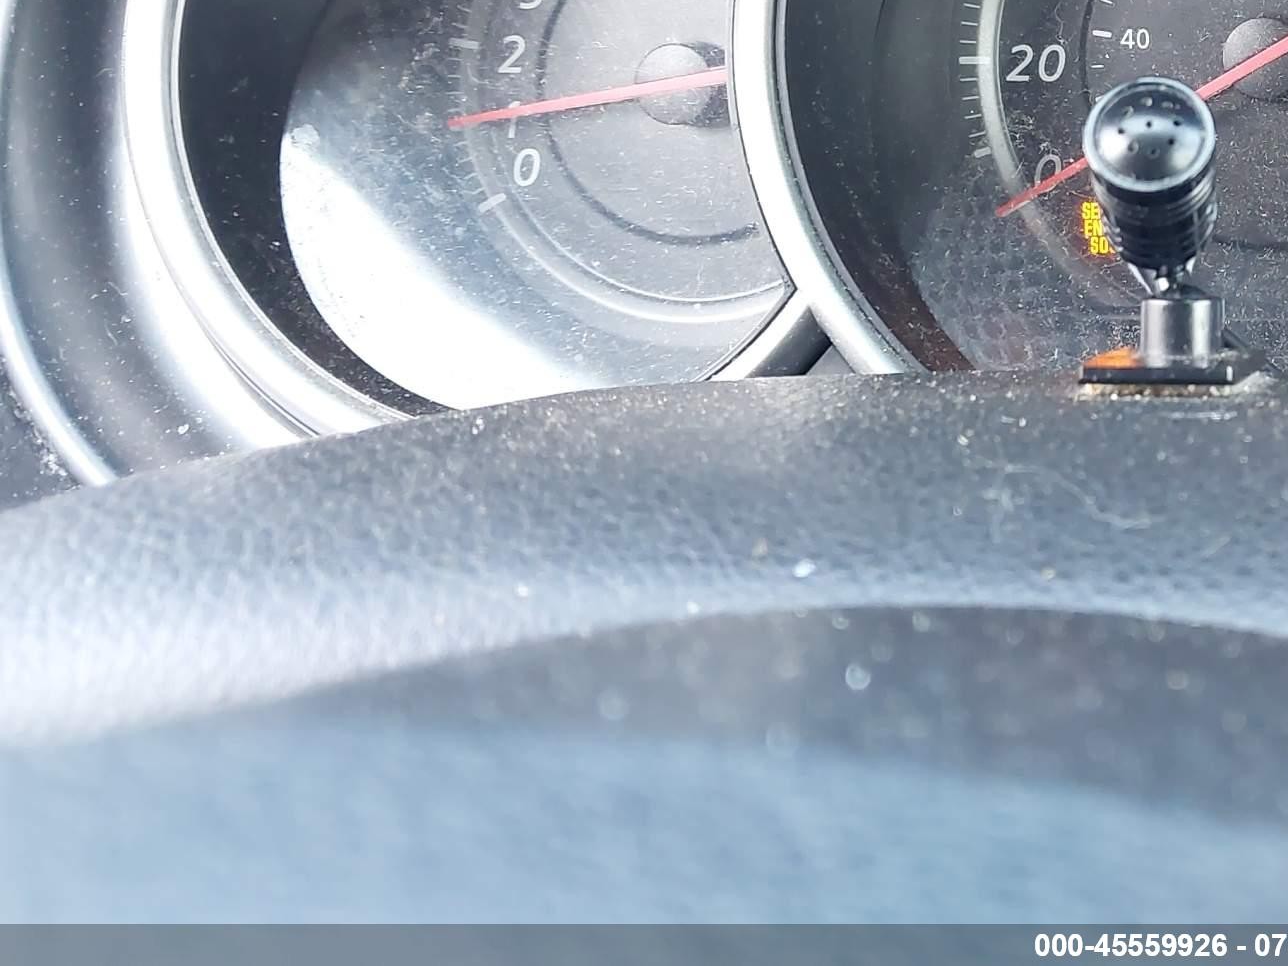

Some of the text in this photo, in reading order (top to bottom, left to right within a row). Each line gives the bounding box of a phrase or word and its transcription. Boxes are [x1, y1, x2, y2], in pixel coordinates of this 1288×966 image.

[497, 35, 526, 74] 2
[1120, 28, 1150, 49] 40
[1005, 44, 1067, 82] 20
[513, 148, 541, 187] 0
